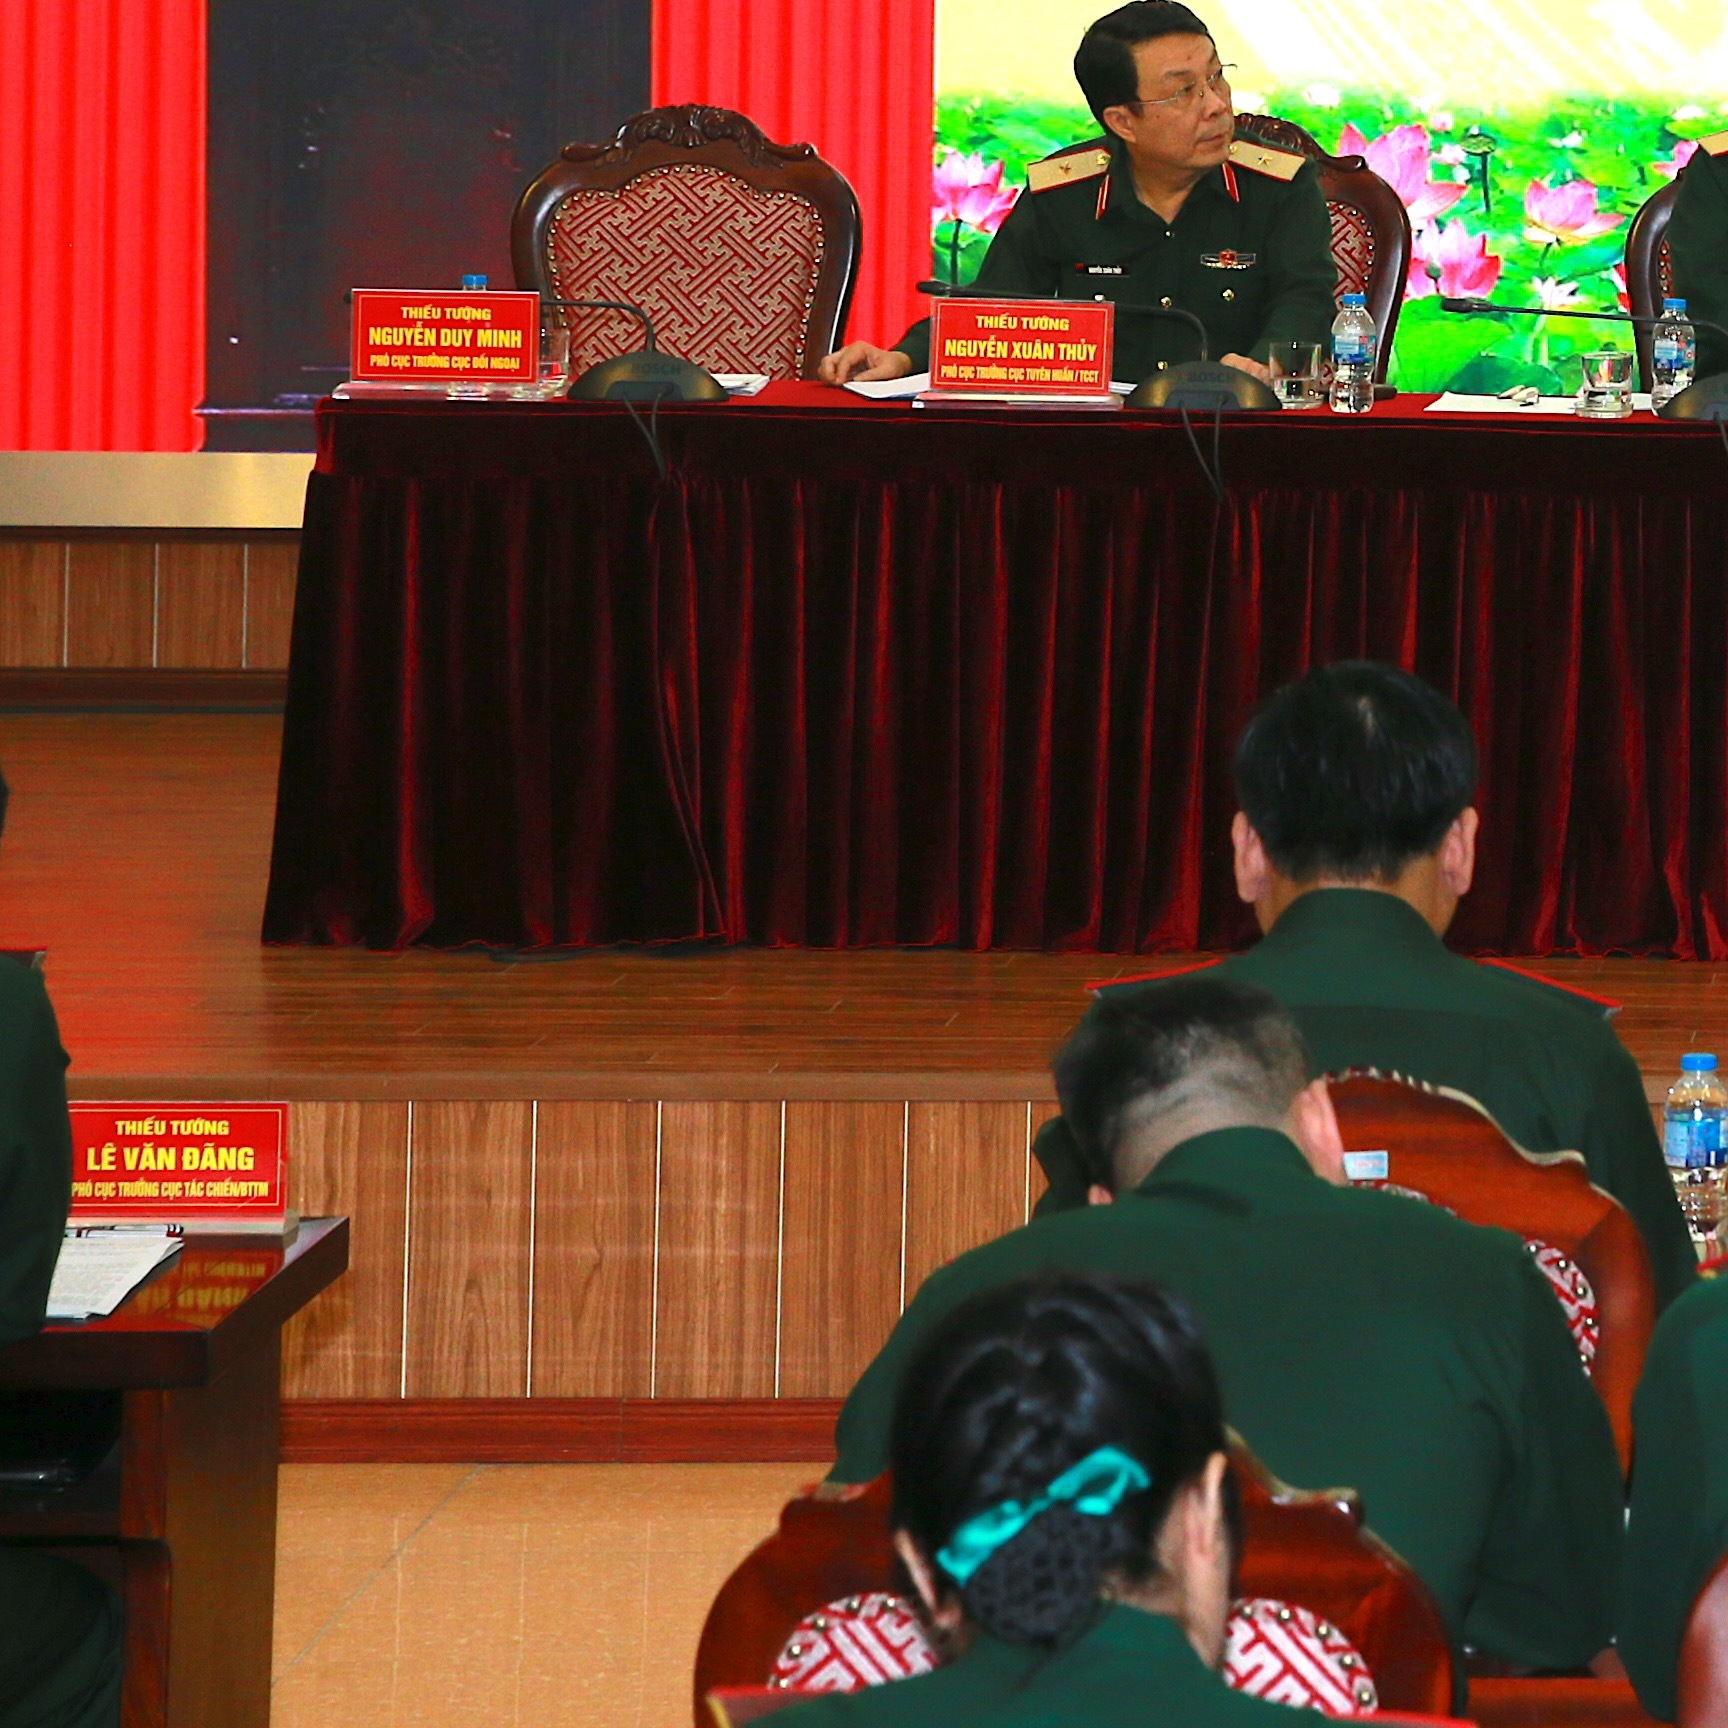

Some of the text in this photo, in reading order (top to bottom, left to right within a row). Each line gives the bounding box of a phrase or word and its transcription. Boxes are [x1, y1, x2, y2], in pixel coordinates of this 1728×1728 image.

[400, 304, 441, 319] THIẾU
[975, 312, 1018, 330] THIẾU
[368, 321, 523, 349] NGUYỄN DUY MINH
[944, 334, 1098, 362] NGUYỄN XUÂN THỦY
[369, 352, 390, 368] PHÓ
[390, 355, 411, 371] CỤC
[451, 356, 472, 372] CỤC
[490, 356, 521, 373] NGOẠI
[940, 363, 958, 378] PHÓ
[958, 366, 976, 382] CỤC
[1008, 368, 1026, 384] CỤC
[1026, 366, 1051, 382] TUYÊN
[114, 1115, 230, 1137] THIẾU TƯỚNG
[86, 1141, 255, 1171] LÊ VĂN ĐÃNG
[71, 1178, 92, 1198] PHÓ
[94, 1182, 117, 1201] CỤC
[117, 1177, 160, 1198] TRƯỞNG
[160, 1181, 183, 1201] CỤC
[183, 1177, 205, 1198] TÁC
